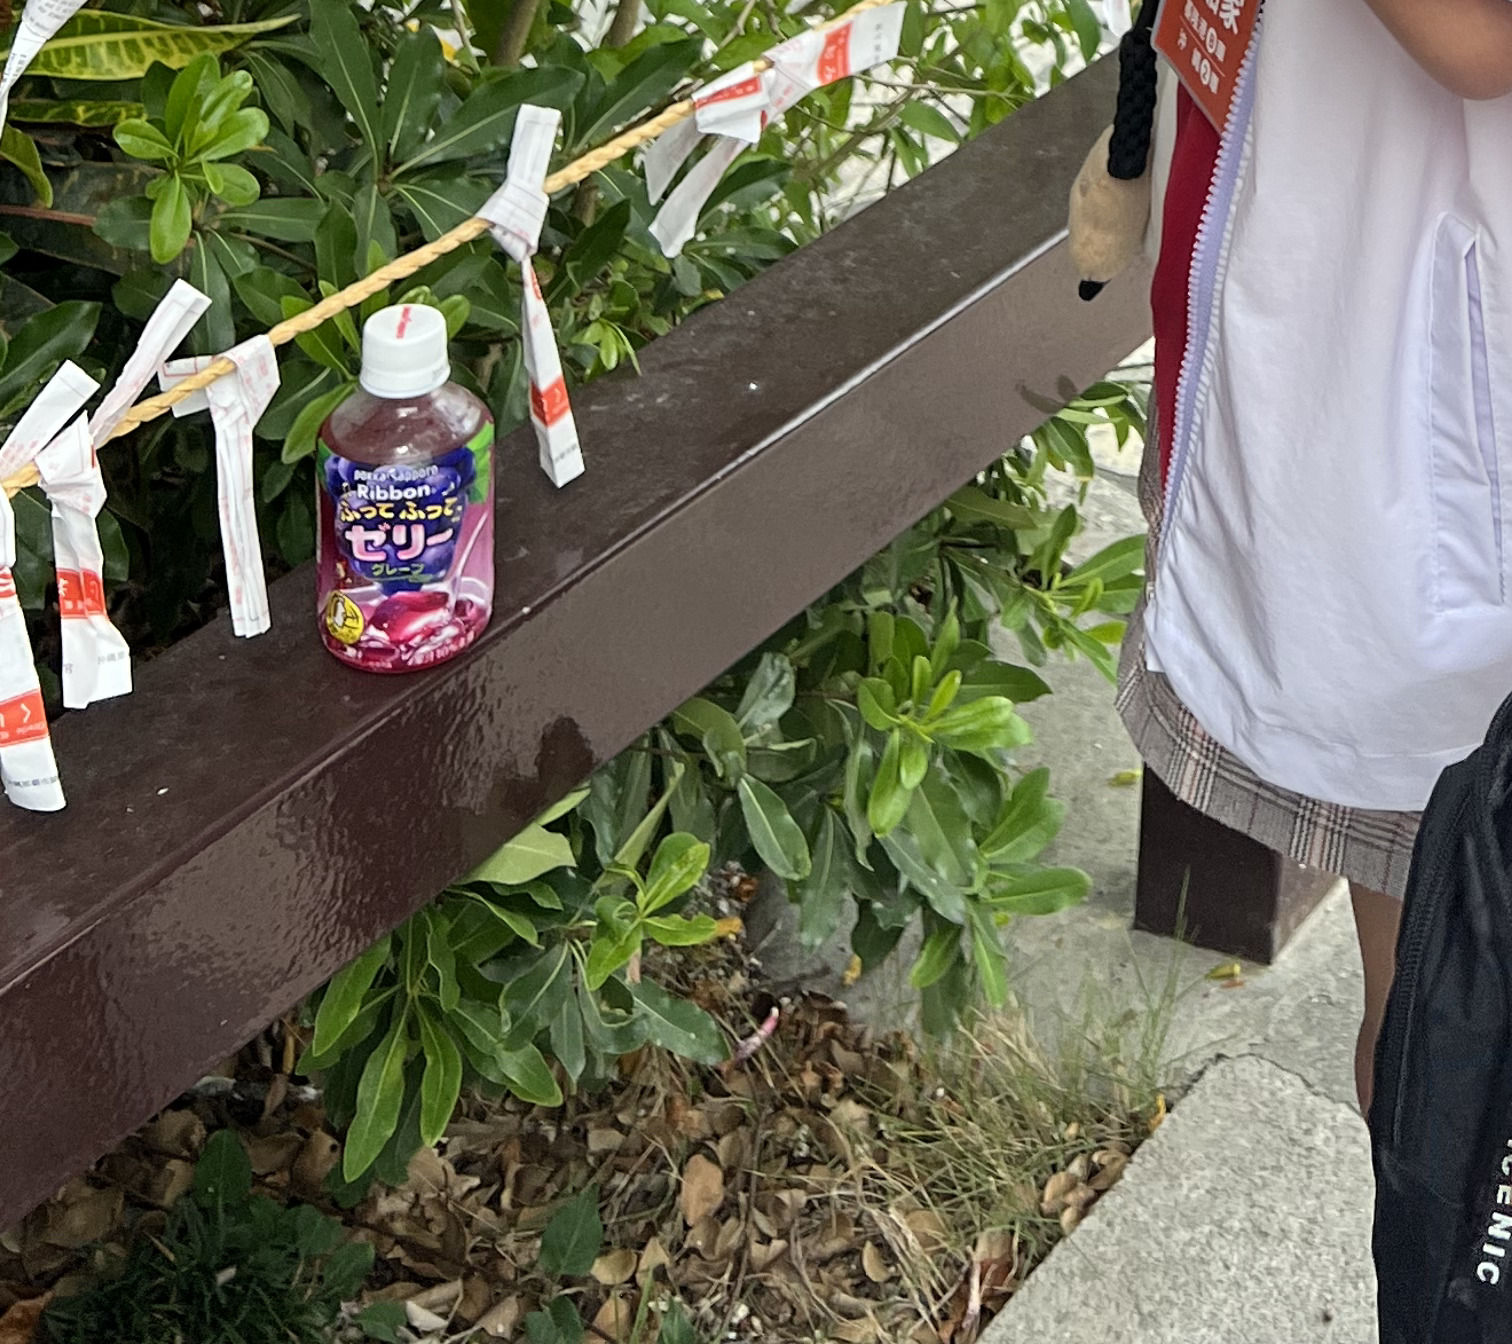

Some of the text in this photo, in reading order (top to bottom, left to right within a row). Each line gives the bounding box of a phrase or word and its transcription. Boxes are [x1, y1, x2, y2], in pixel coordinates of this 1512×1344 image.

[356, 484, 431, 501] Ribbon
[344, 521, 454, 562] ゼリー
